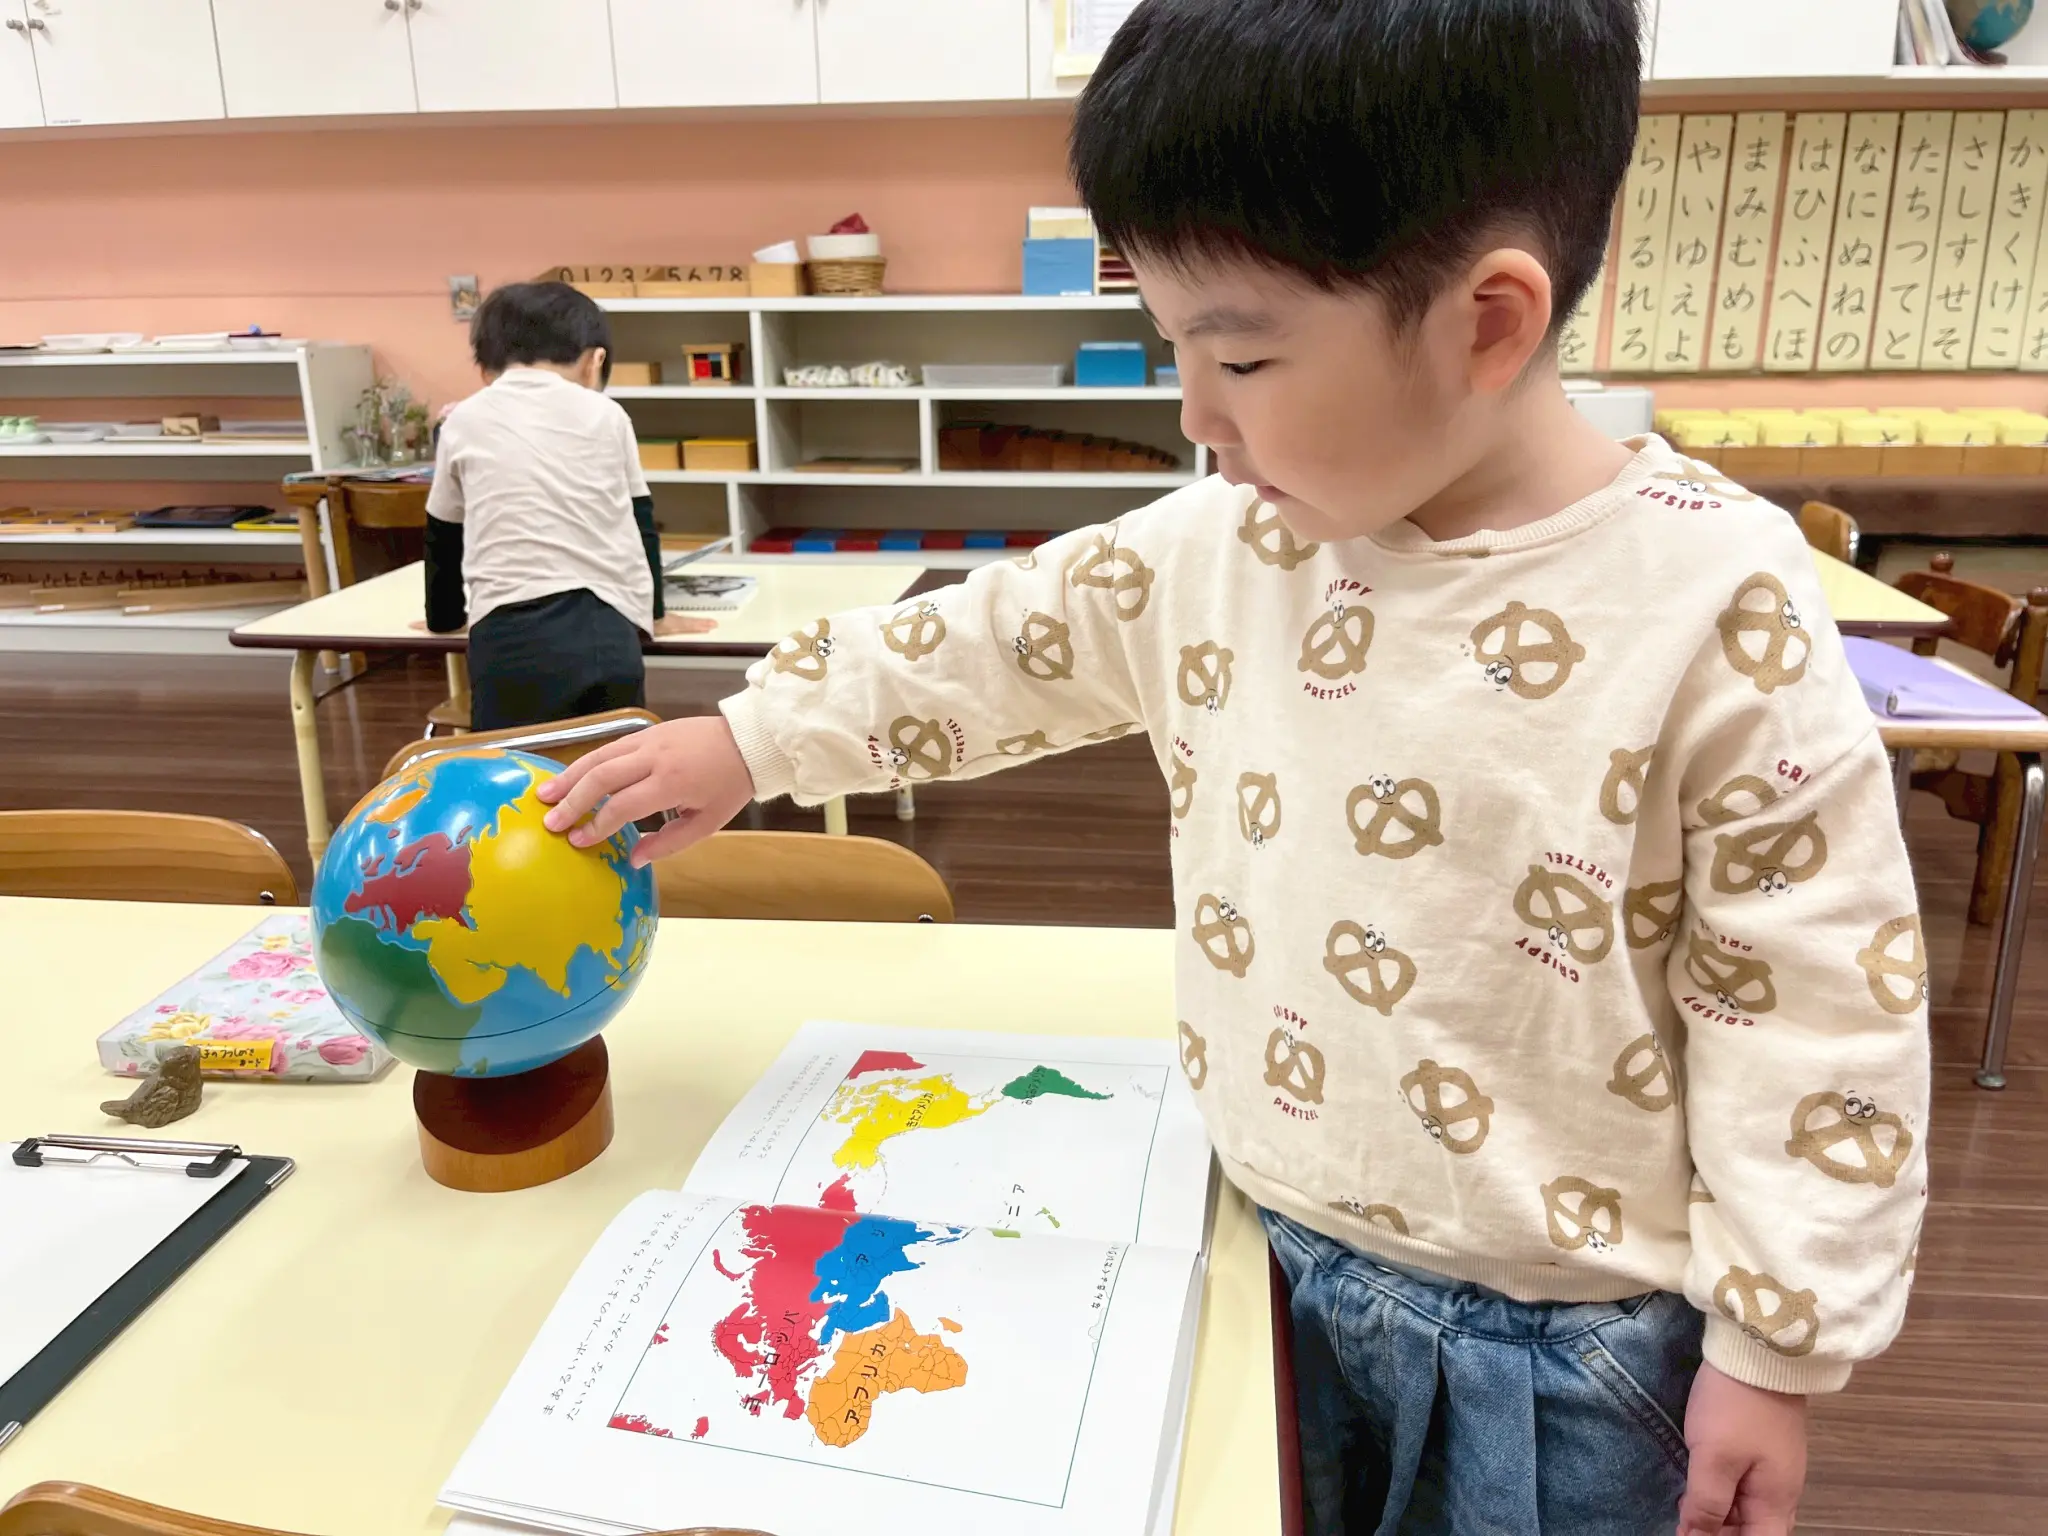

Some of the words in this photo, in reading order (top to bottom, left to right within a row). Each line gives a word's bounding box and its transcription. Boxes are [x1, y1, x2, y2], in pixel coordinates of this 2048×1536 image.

[1620, 138, 1665, 361] らりるれろ
[1665, 140, 1722, 362] やいゆえよ
[1722, 137, 1771, 358] まみむめも
[1772, 137, 1830, 360] はひふへほ
[1827, 138, 1887, 358] なにぬねの
[1884, 136, 1940, 360] たちつてと
[1933, 136, 1988, 360] さしすせそ
[1987, 136, 2044, 356] かきくけこ
[1636, 486, 1722, 510] CRISPY
[1304, 682, 1356, 700] PRETZEL
[946, 718, 965, 762] PRETZEL
[1173, 735, 1194, 757] PRE
[1777, 759, 1811, 786] CRI
[1545, 852, 1613, 888] PRETZEL
[1515, 937, 1580, 983] CRISPY
[1682, 997, 1754, 1026] CRISPY
[906, 1092, 935, 1128] きたアメリカ
[1273, 1097, 1319, 1121] PRETZEL
[565, 1361, 604, 1421] たいらな
[604, 1313, 631, 1353] かみに
[630, 1258, 664, 1304] ひろげて
[743, 1310, 800, 1412] ヨーロッパ
[844, 1343, 887, 1424] アフリカ
